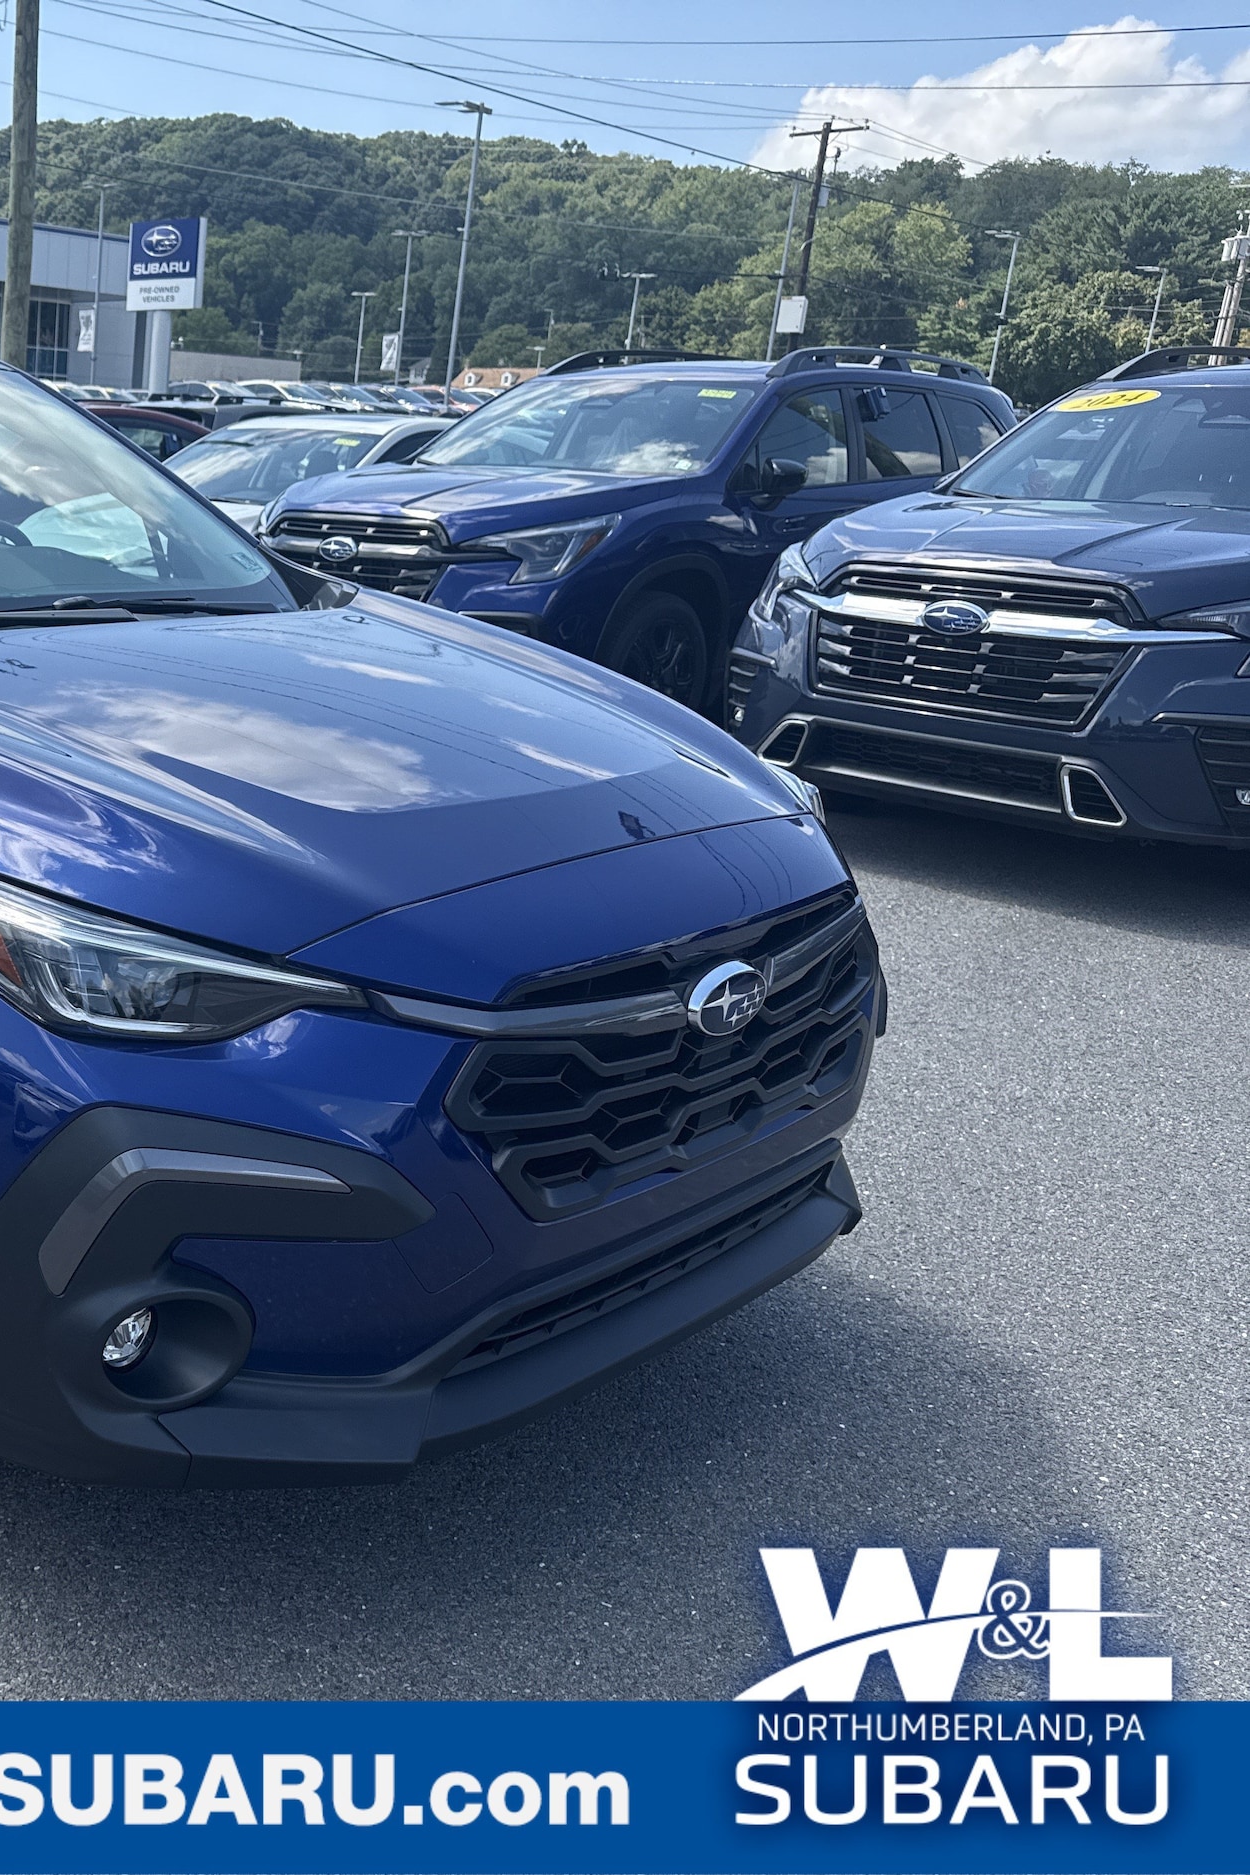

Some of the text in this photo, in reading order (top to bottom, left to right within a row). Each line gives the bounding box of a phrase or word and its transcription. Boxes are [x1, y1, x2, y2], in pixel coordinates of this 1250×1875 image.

[132, 260, 190, 275] SUBARU
[139, 286, 180, 294] PRE-OWNED
[142, 295, 175, 303] VEHICLES
[1069, 391, 1148, 409] 2024
